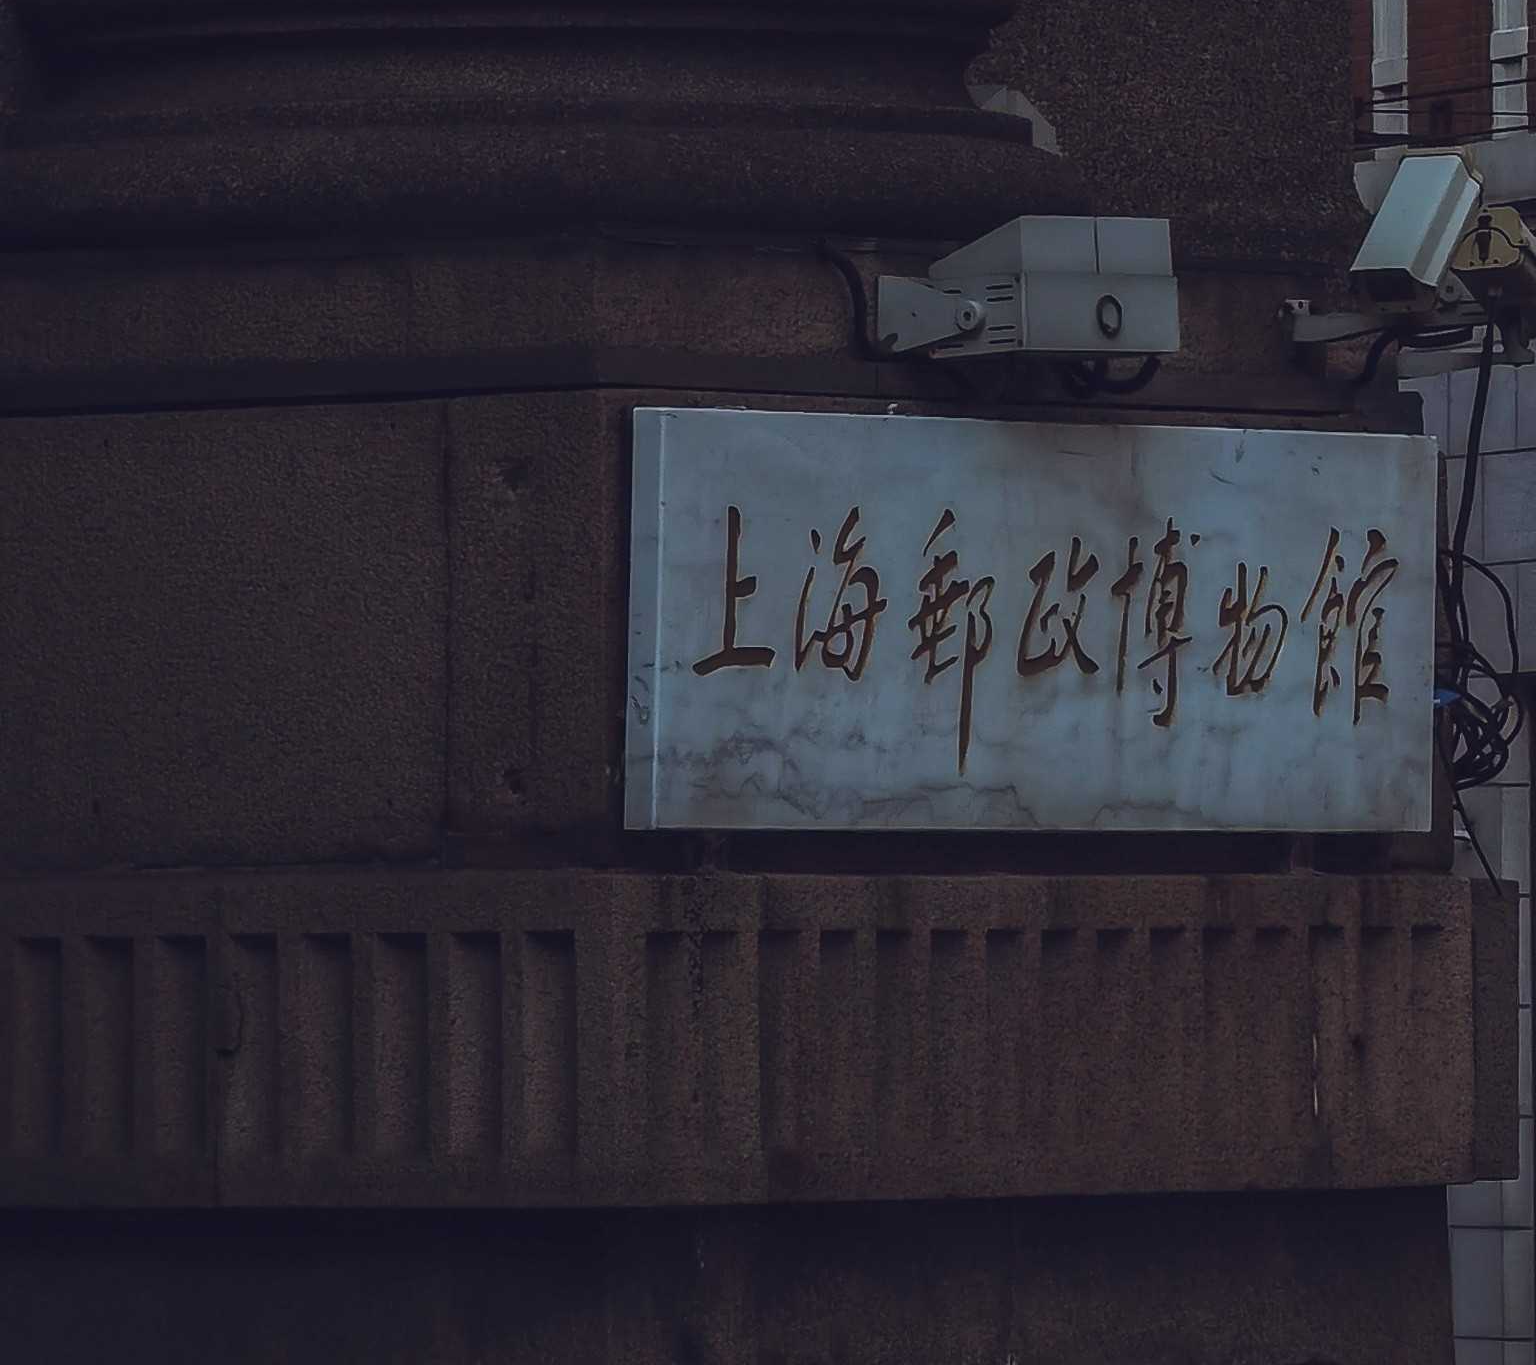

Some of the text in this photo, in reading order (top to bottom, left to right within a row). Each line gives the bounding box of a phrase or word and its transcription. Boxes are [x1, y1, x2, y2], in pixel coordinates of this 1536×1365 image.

[693, 505, 1400, 777] 上海郵政博物館
